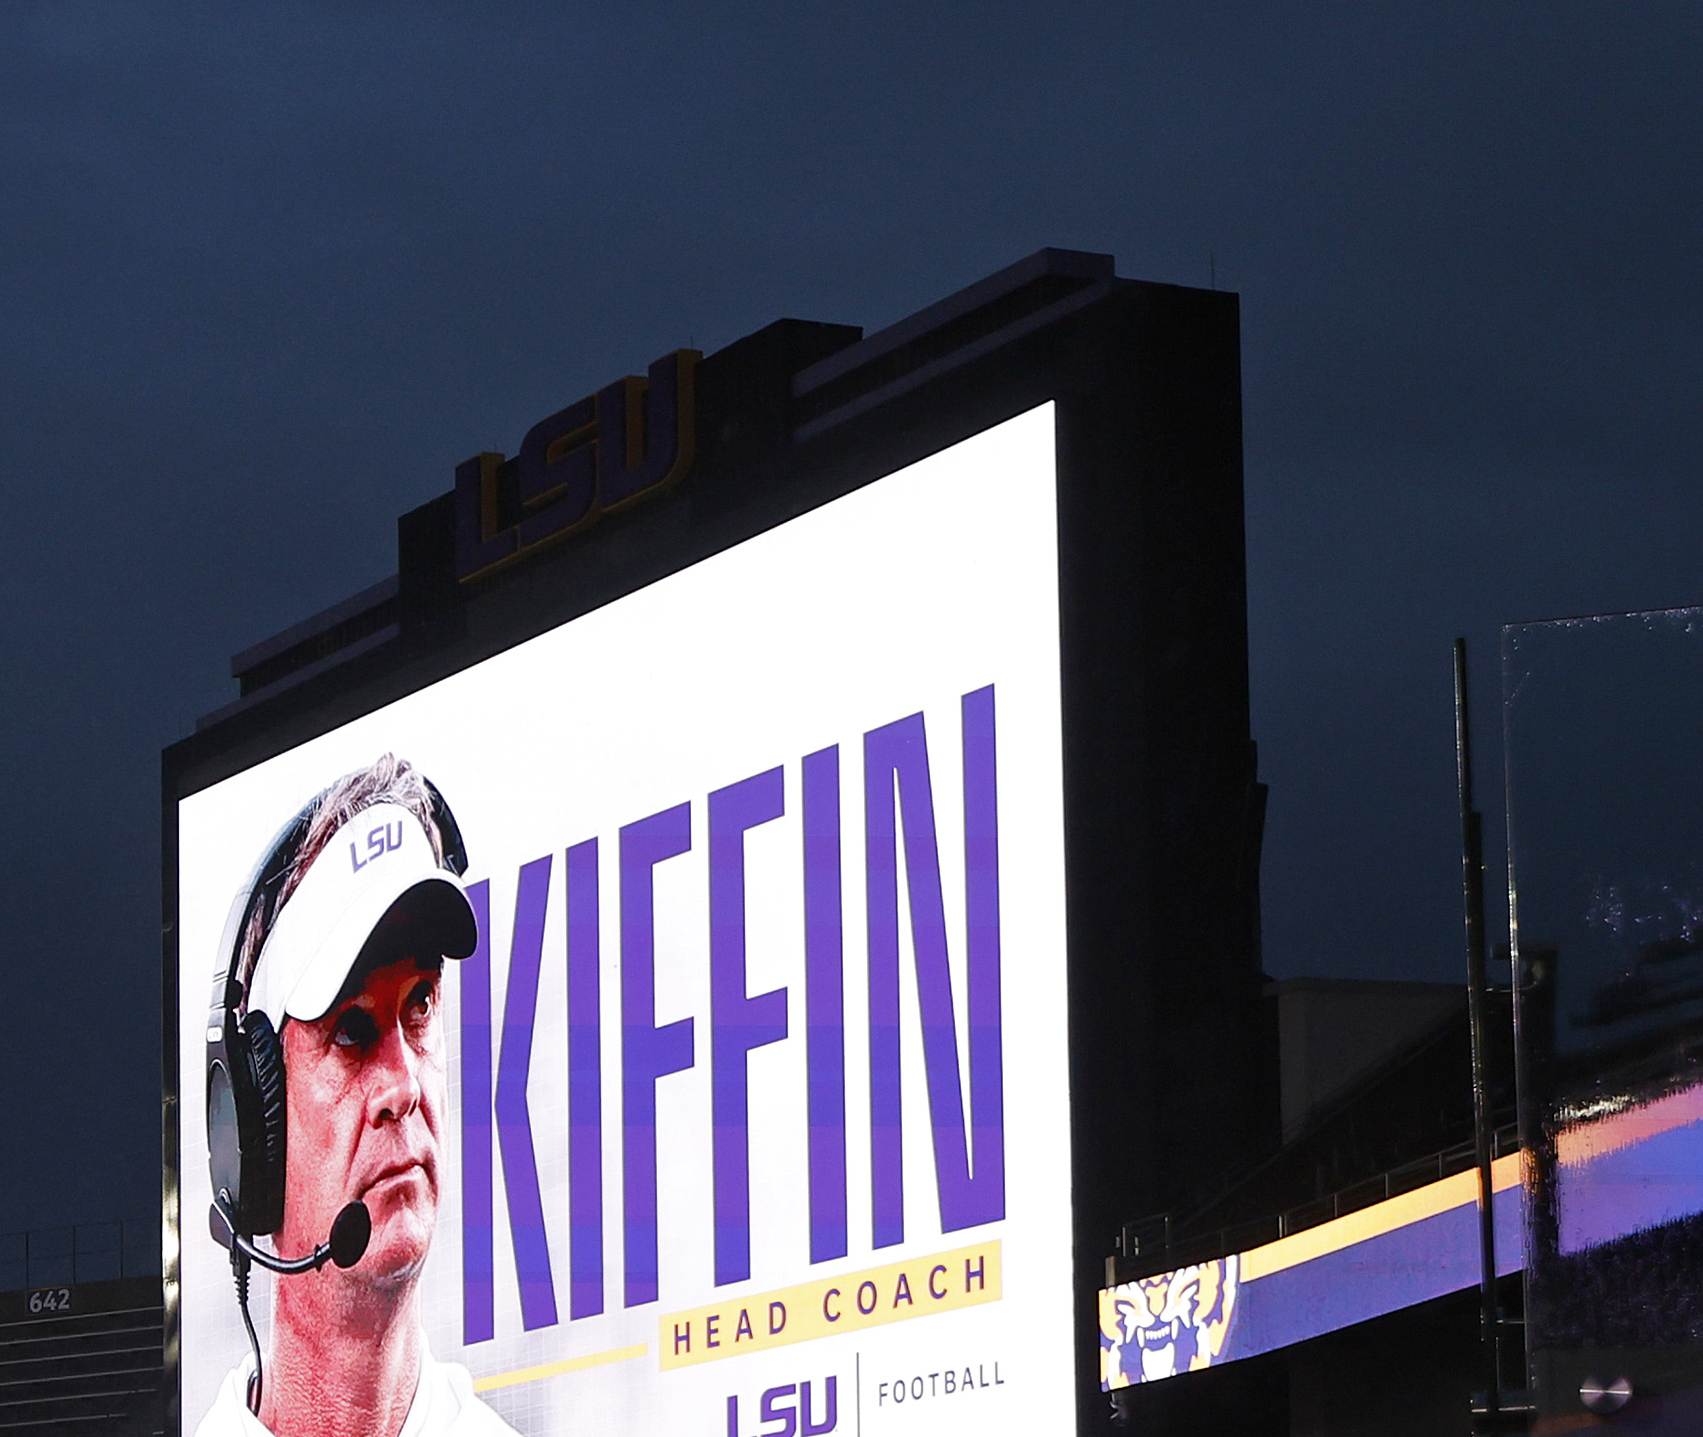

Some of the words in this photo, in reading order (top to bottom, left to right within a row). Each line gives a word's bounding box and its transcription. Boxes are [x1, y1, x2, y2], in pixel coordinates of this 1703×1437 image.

[456, 349, 702, 583] LSU
[350, 820, 403, 874] LSU
[460, 683, 1006, 1346] KIFFIN
[29, 1288, 70, 1313] 642
[674, 1301, 787, 1355] HEAD
[822, 1255, 985, 1323] COACH
[878, 1361, 1005, 1406] FOOTBALL
